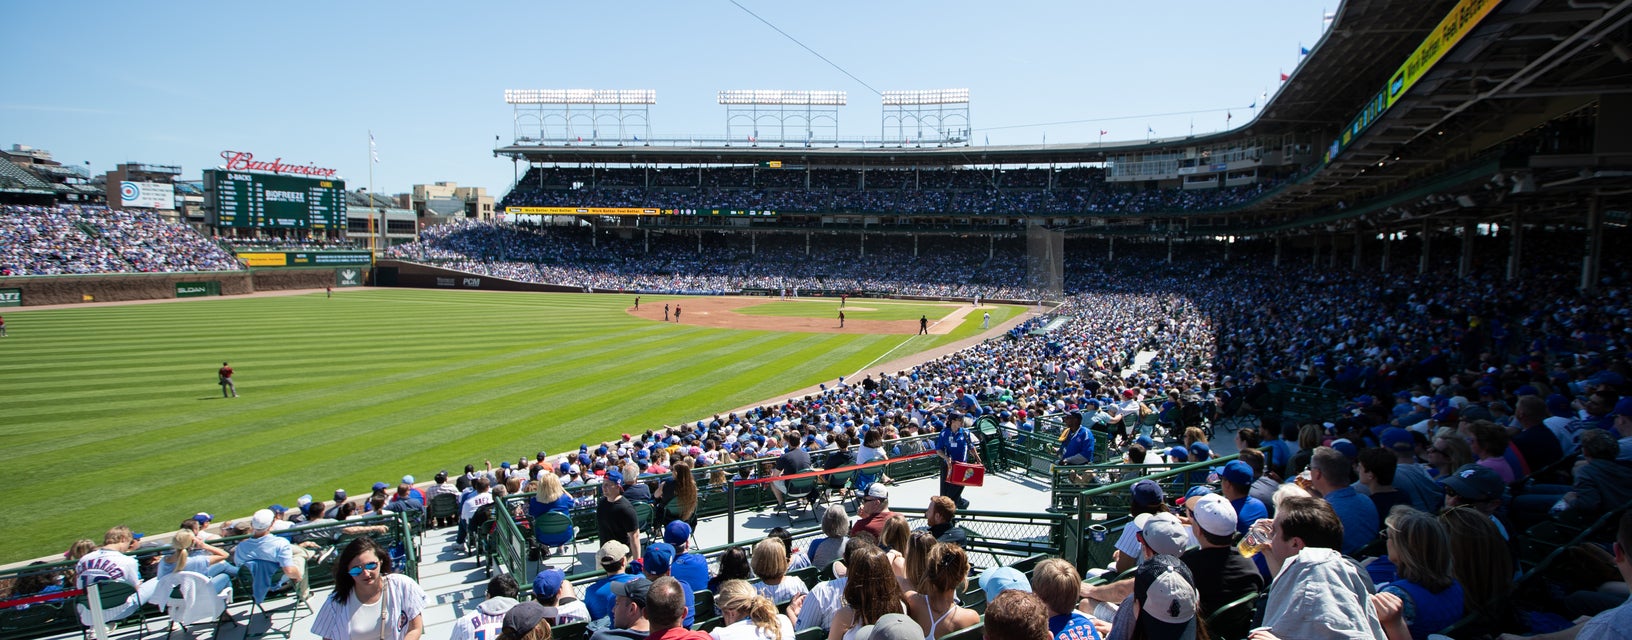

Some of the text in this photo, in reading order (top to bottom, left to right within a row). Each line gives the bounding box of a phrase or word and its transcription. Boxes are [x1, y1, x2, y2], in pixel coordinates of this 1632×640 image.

[220, 151, 336, 176] Budweiser
[227, 173, 252, 181] D-BACKS
[265, 190, 305, 199] BIOFREEZE
[463, 278, 480, 287] PCM
